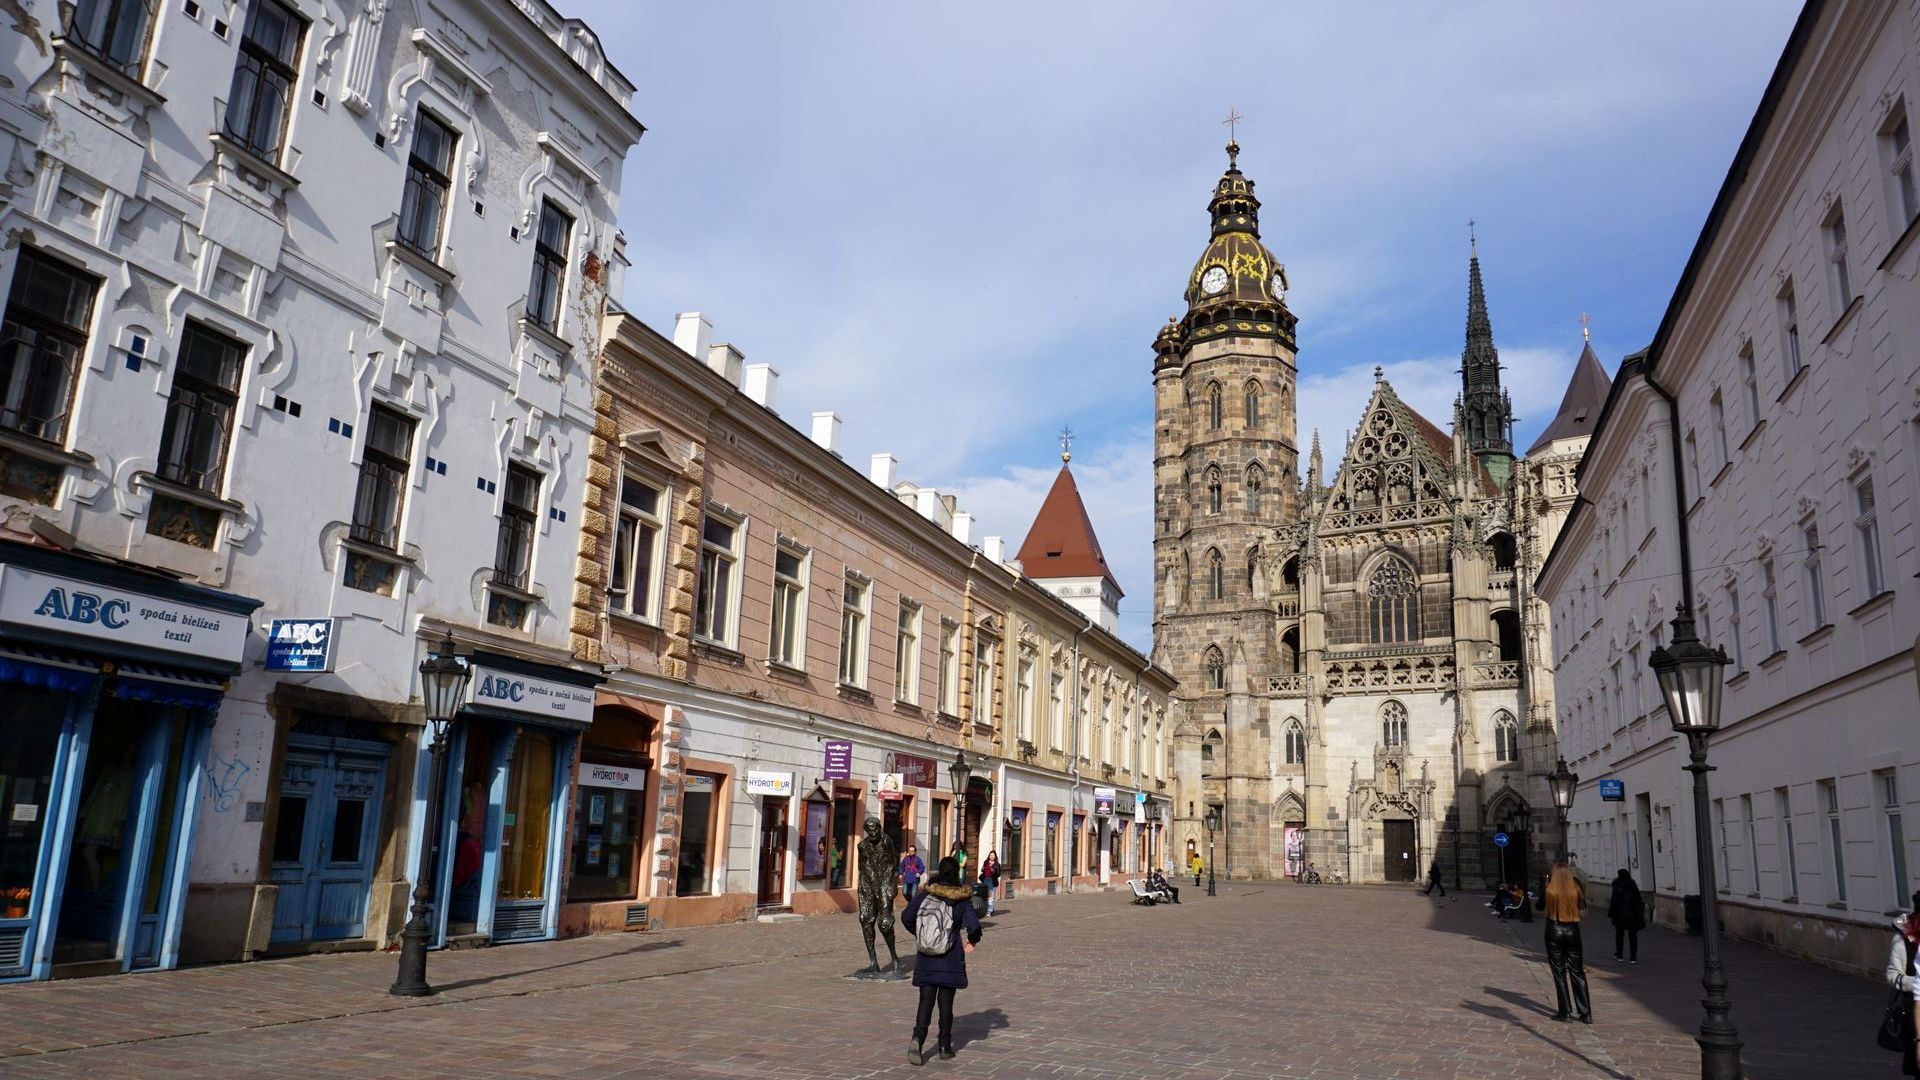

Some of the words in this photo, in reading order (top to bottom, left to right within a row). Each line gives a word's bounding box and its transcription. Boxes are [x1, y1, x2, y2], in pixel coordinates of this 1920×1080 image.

[34, 587, 130, 629] ABC
[139, 606, 178, 622] spodná
[182, 614, 220, 631] bielizeň
[164, 629, 192, 643] textil
[274, 623, 326, 644] ABC
[478, 675, 524, 702] ABC
[529, 686, 549, 696] spodná
[555, 690, 571, 700] nočná
[551, 702, 566, 711] textil
[749, 779, 790, 789] HYDROTOUR
